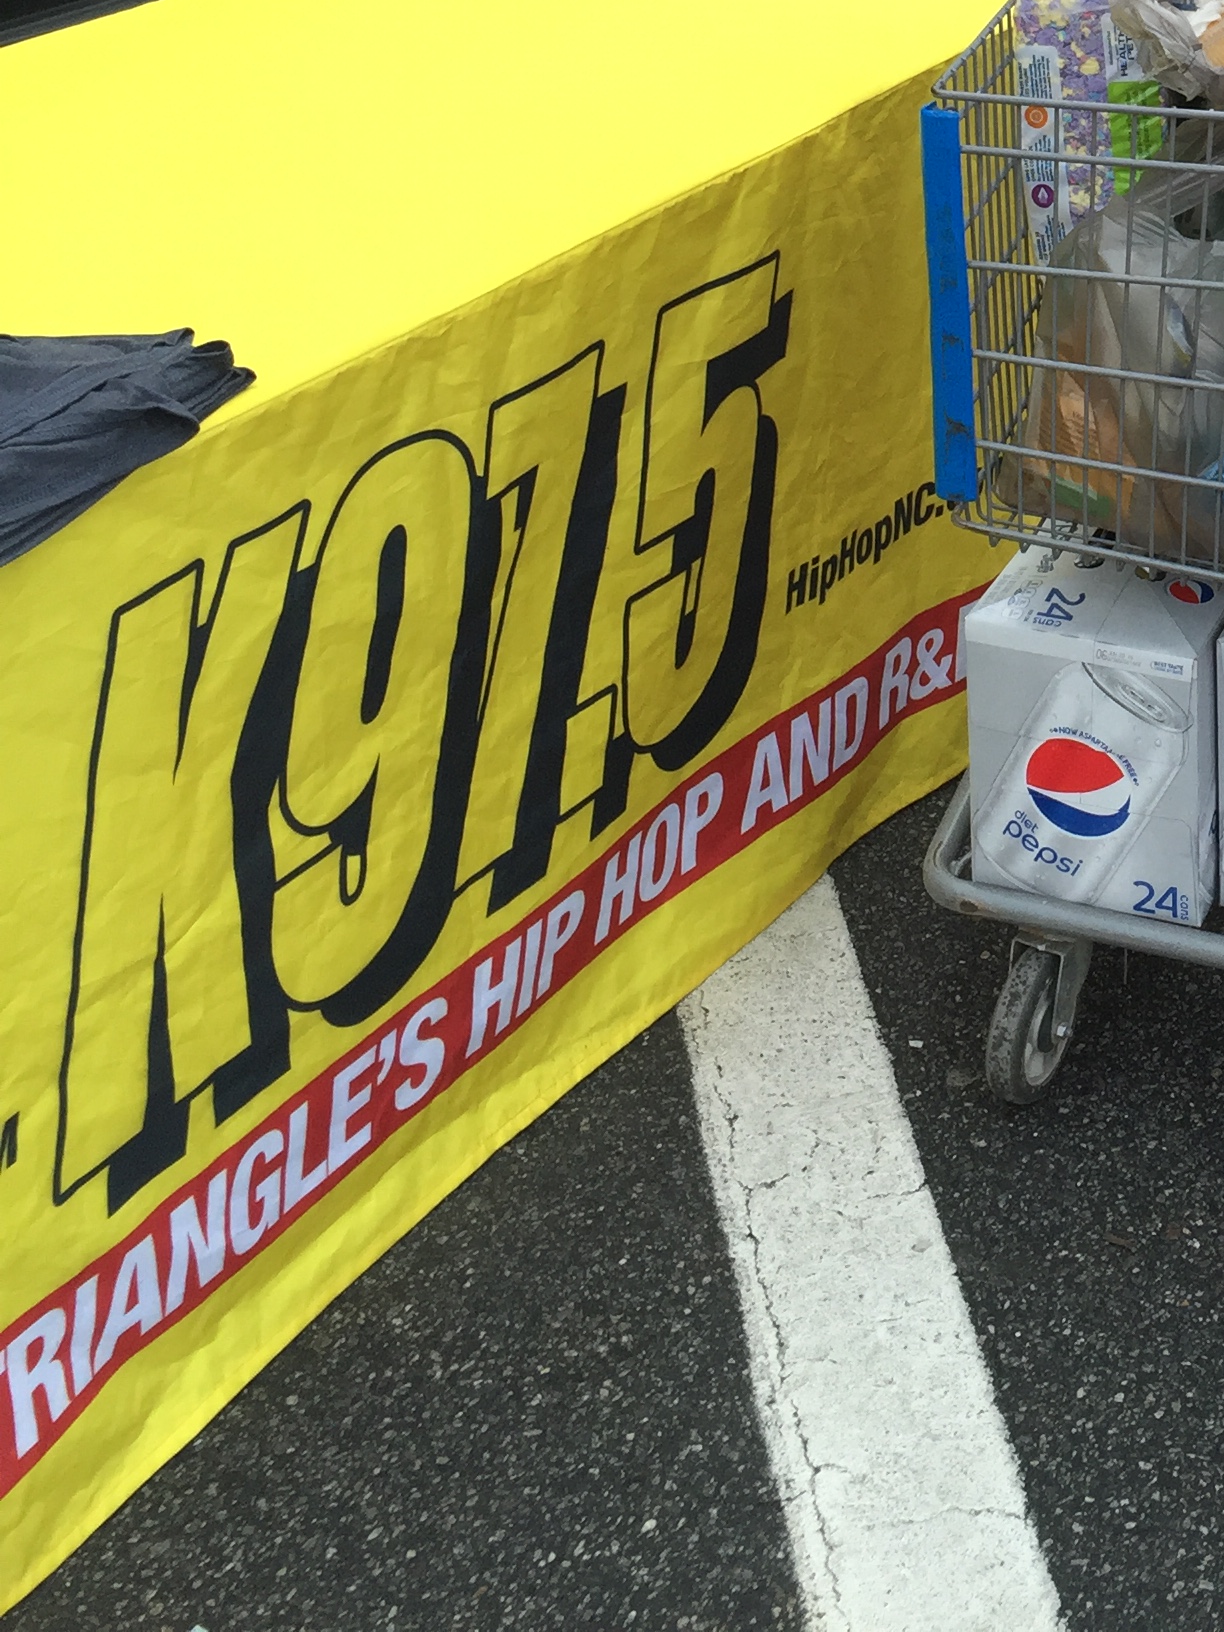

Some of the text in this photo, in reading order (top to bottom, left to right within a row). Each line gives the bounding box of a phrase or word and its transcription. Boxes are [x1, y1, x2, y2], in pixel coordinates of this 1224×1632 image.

[786, 458, 1003, 615] HipHopNC.
[1037, 587, 1086, 622] 24
[1078, 730, 1126, 761] ASPARTAE
[1014, 809, 1040, 834] diet
[1002, 819, 1084, 877] pepsi
[1132, 880, 1190, 921] 24 cans
[0, 996, 448, 1458] RIANGLE'S
[465, 889, 586, 1060] HIP
[594, 771, 724, 946] HOP
[740, 675, 870, 835] AND
